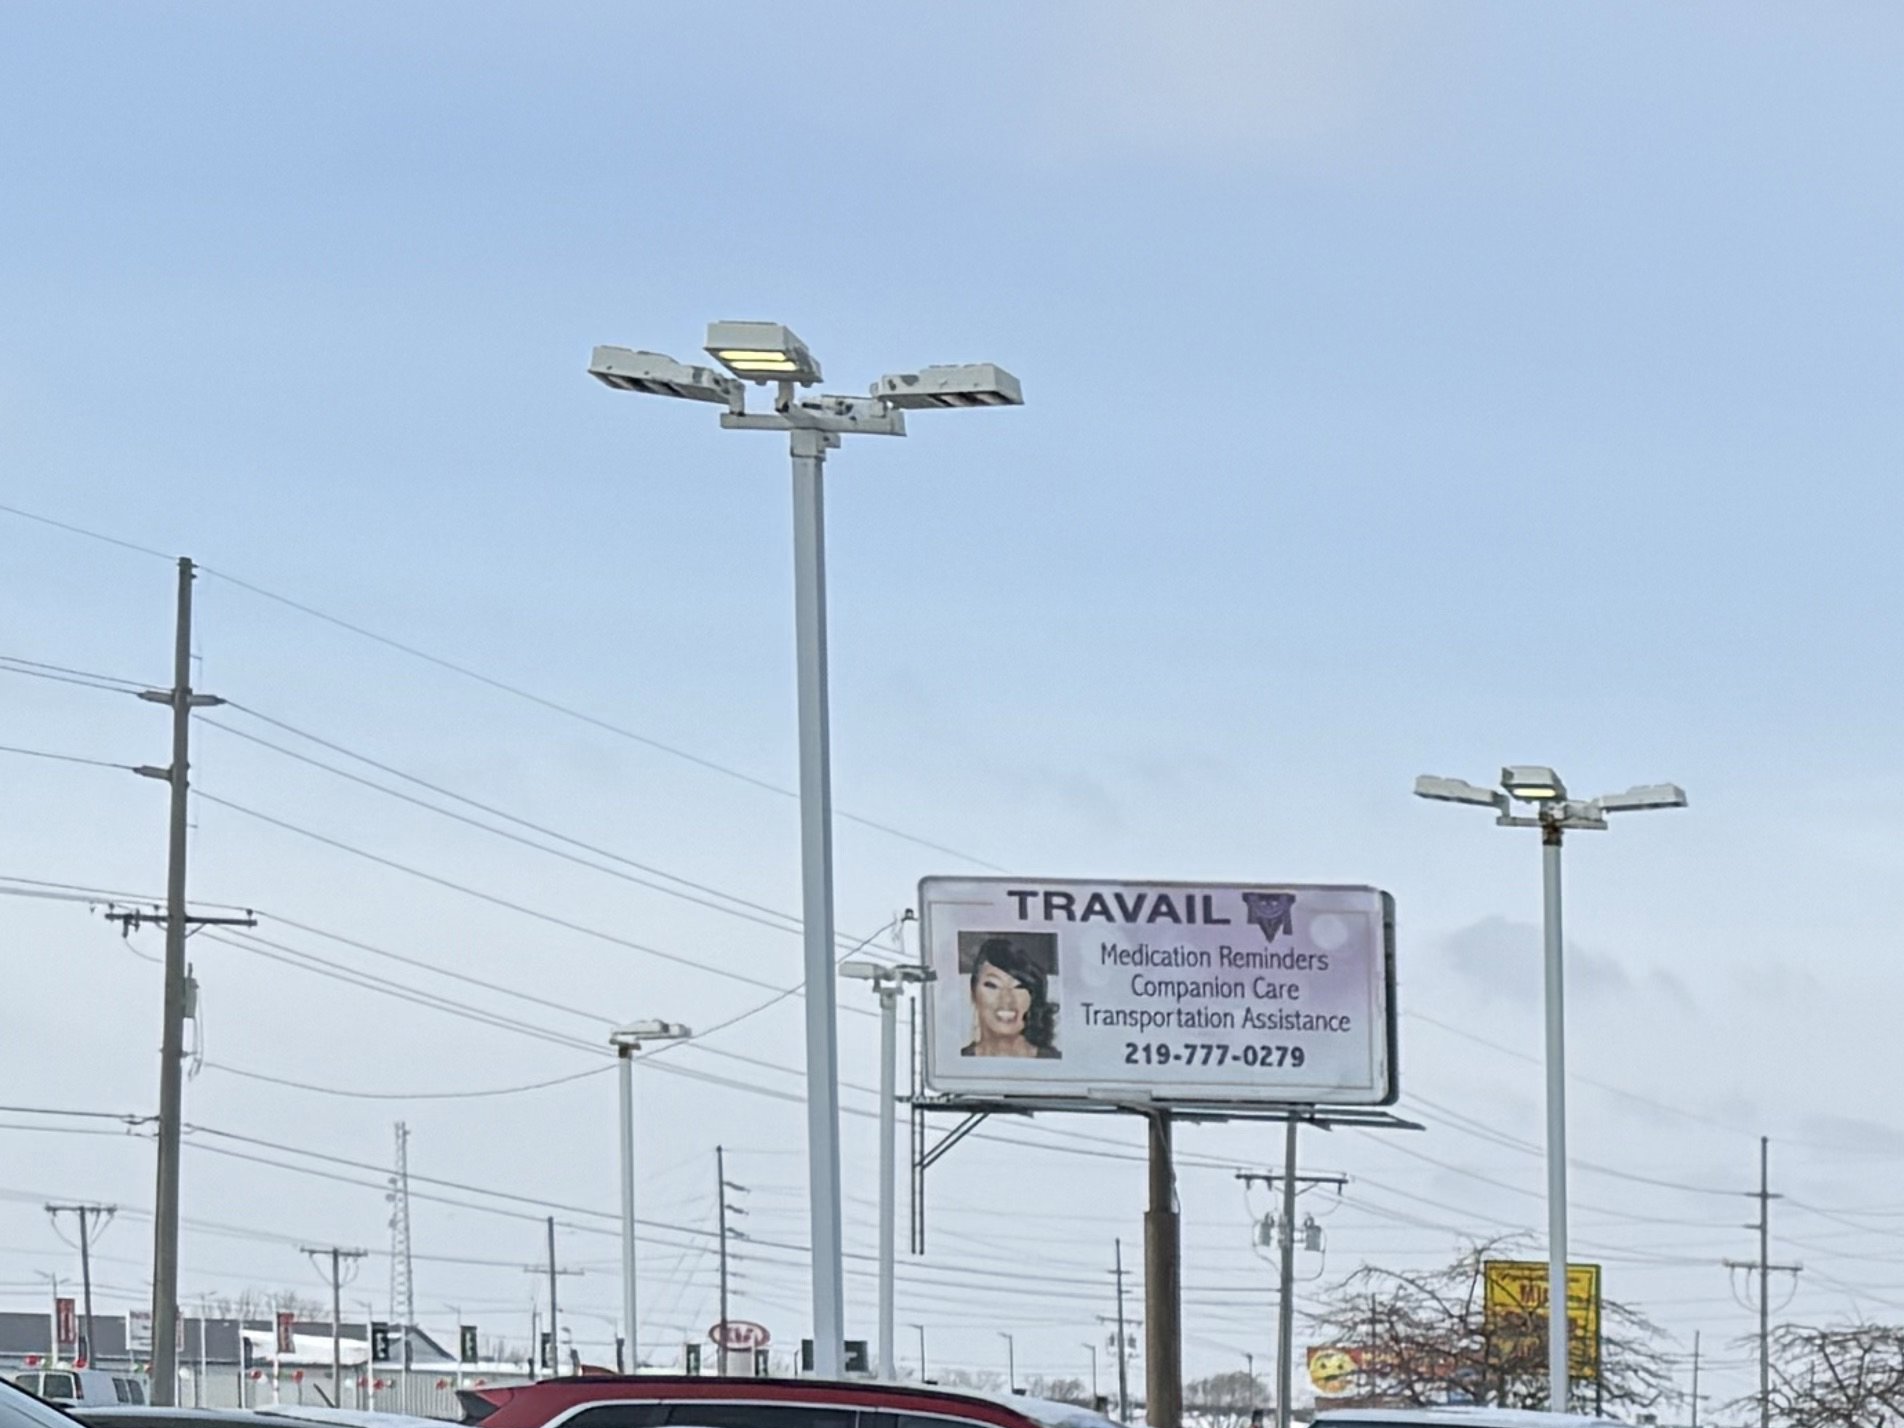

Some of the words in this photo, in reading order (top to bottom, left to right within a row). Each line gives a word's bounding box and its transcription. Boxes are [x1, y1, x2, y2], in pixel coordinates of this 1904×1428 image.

[1006, 889, 1232, 926] TRAVAIL
[1100, 941, 1213, 969] Medication
[1219, 945, 1330, 972] Reminders
[1131, 973, 1246, 1003] Companion
[1252, 976, 1300, 1000] Care
[1081, 1002, 1236, 1034] Transportation
[1240, 1006, 1352, 1032] Assistance
[1123, 1042, 1306, 1068] 219-777-0279
